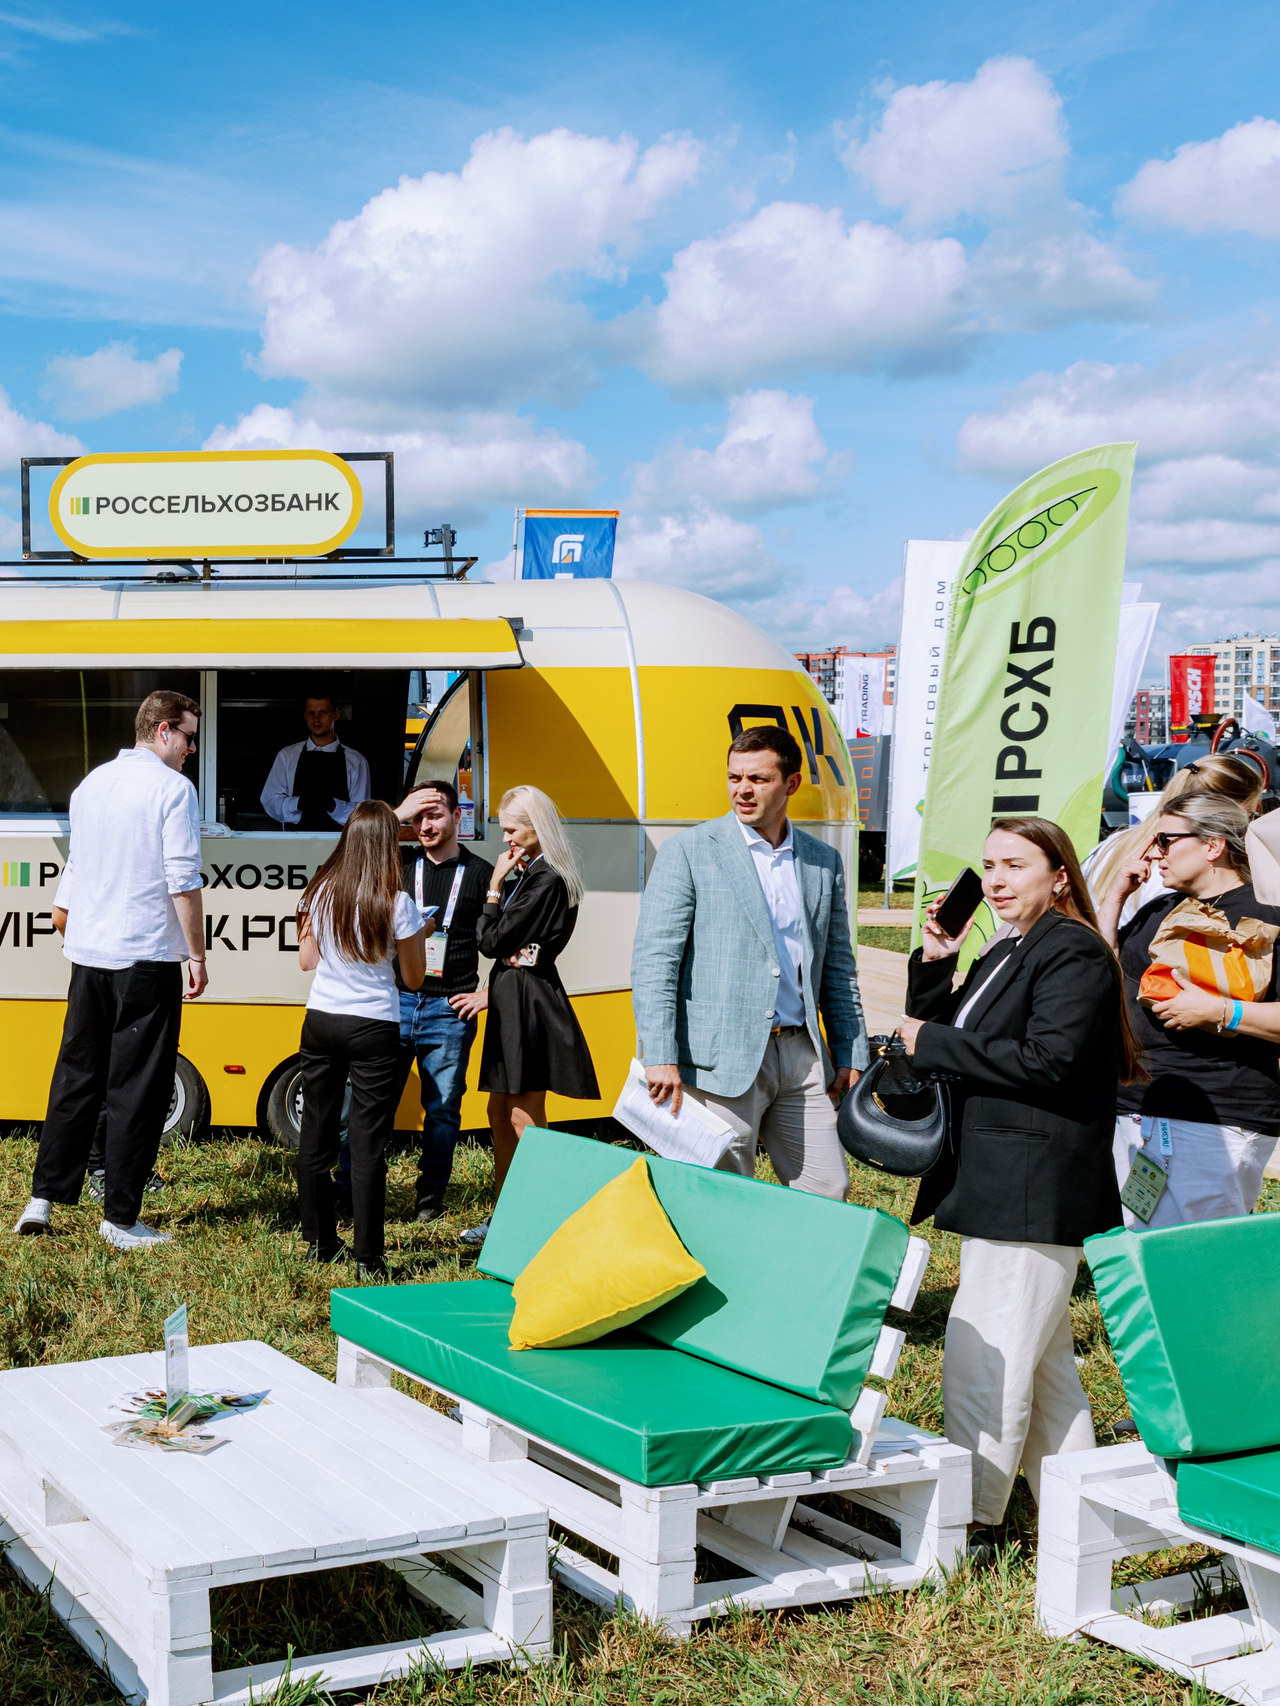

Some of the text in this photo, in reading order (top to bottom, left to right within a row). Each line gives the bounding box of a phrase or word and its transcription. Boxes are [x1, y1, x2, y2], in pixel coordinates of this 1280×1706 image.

[96, 493, 340, 515] РОССЕЛЬХОЗБАНК
[934, 581, 947, 628] ДОМ
[861, 674, 869, 723] TRADING
[995, 616, 1057, 780] РСХБ
[1160, 1120, 1170, 1148] ЛИЗИНГ
